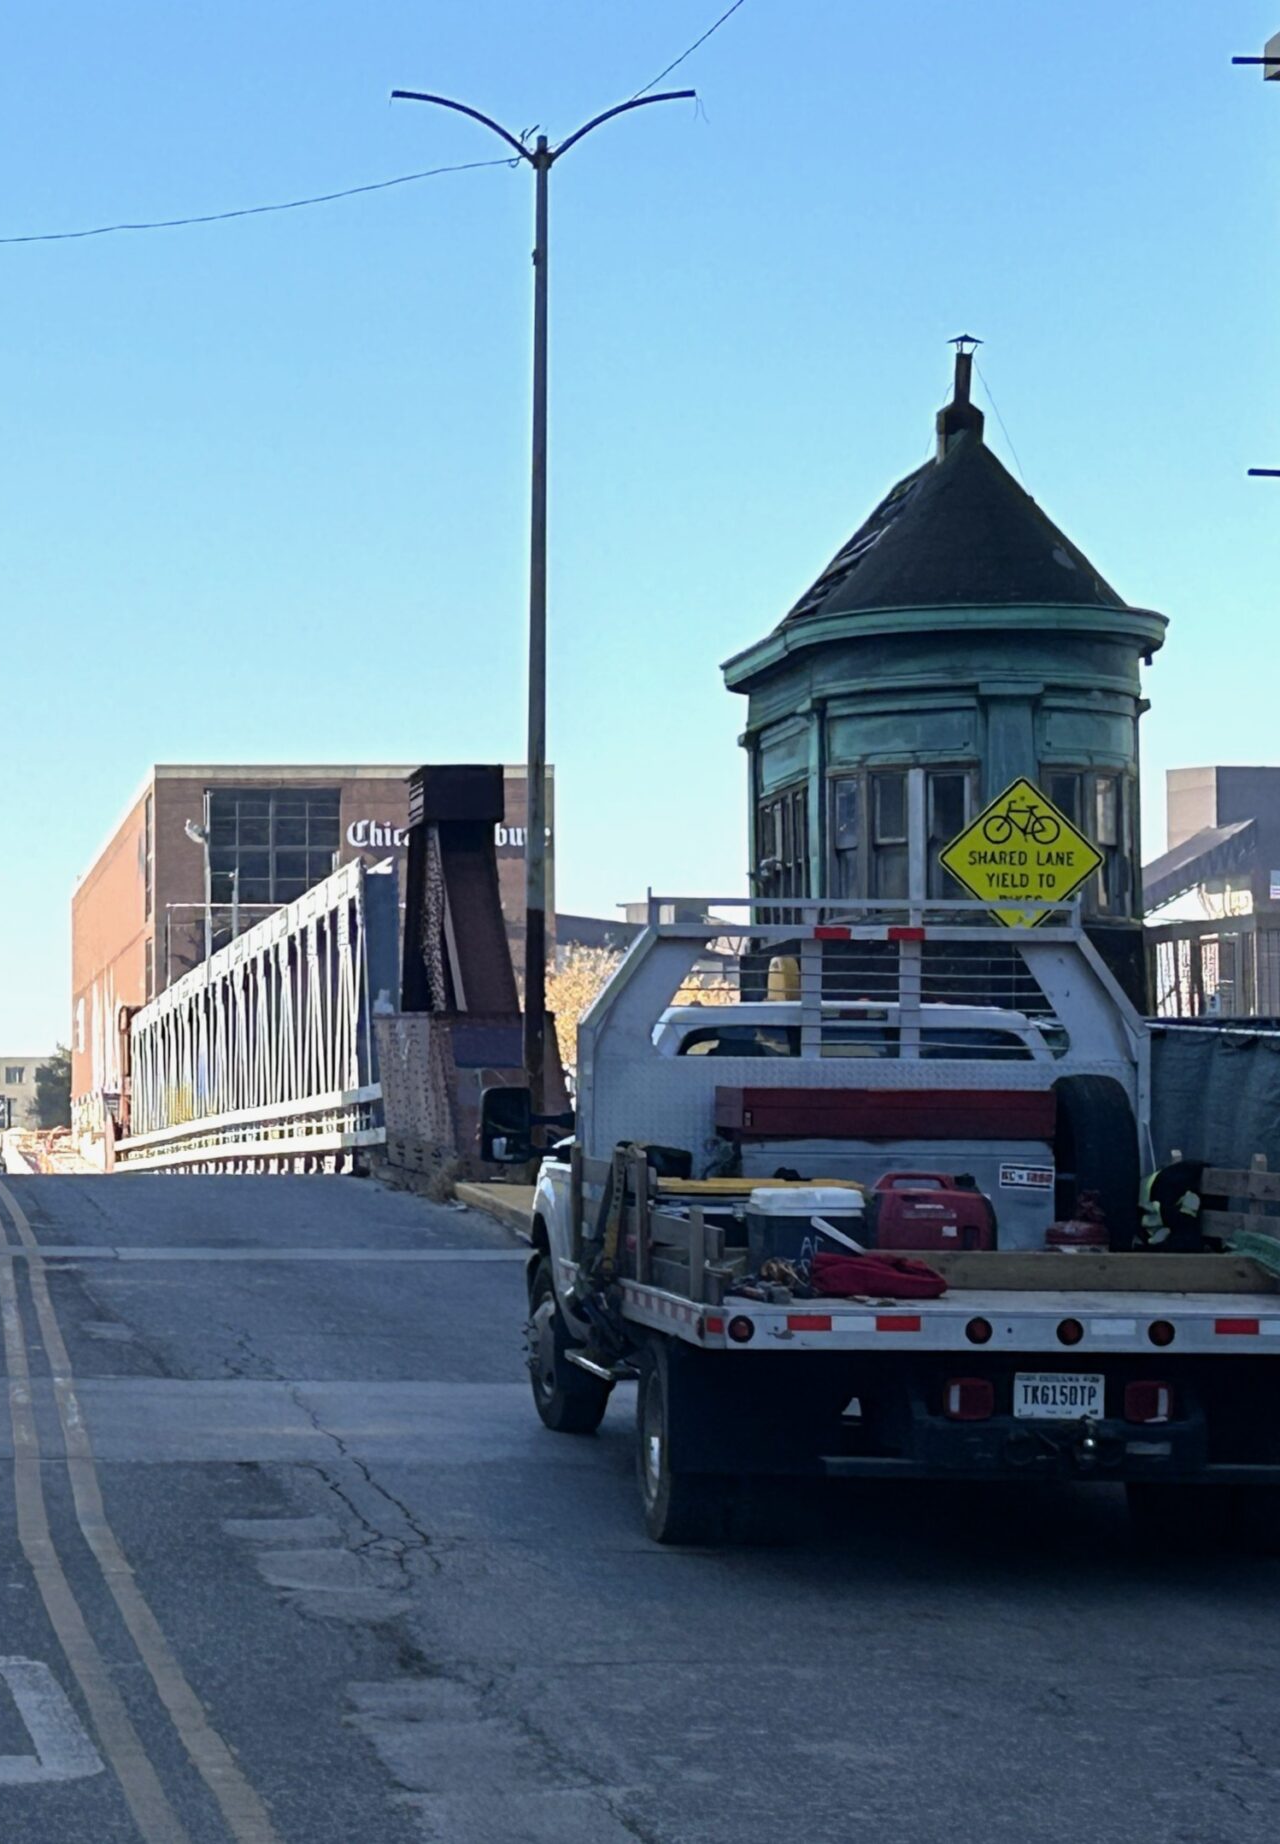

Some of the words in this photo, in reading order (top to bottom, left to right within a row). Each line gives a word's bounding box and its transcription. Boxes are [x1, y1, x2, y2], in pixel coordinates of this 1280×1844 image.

[968, 851, 1028, 866] SHARED
[1036, 851, 1075, 867] LANE
[986, 873, 1030, 888] YIELD
[1038, 873, 1056, 889] TO
